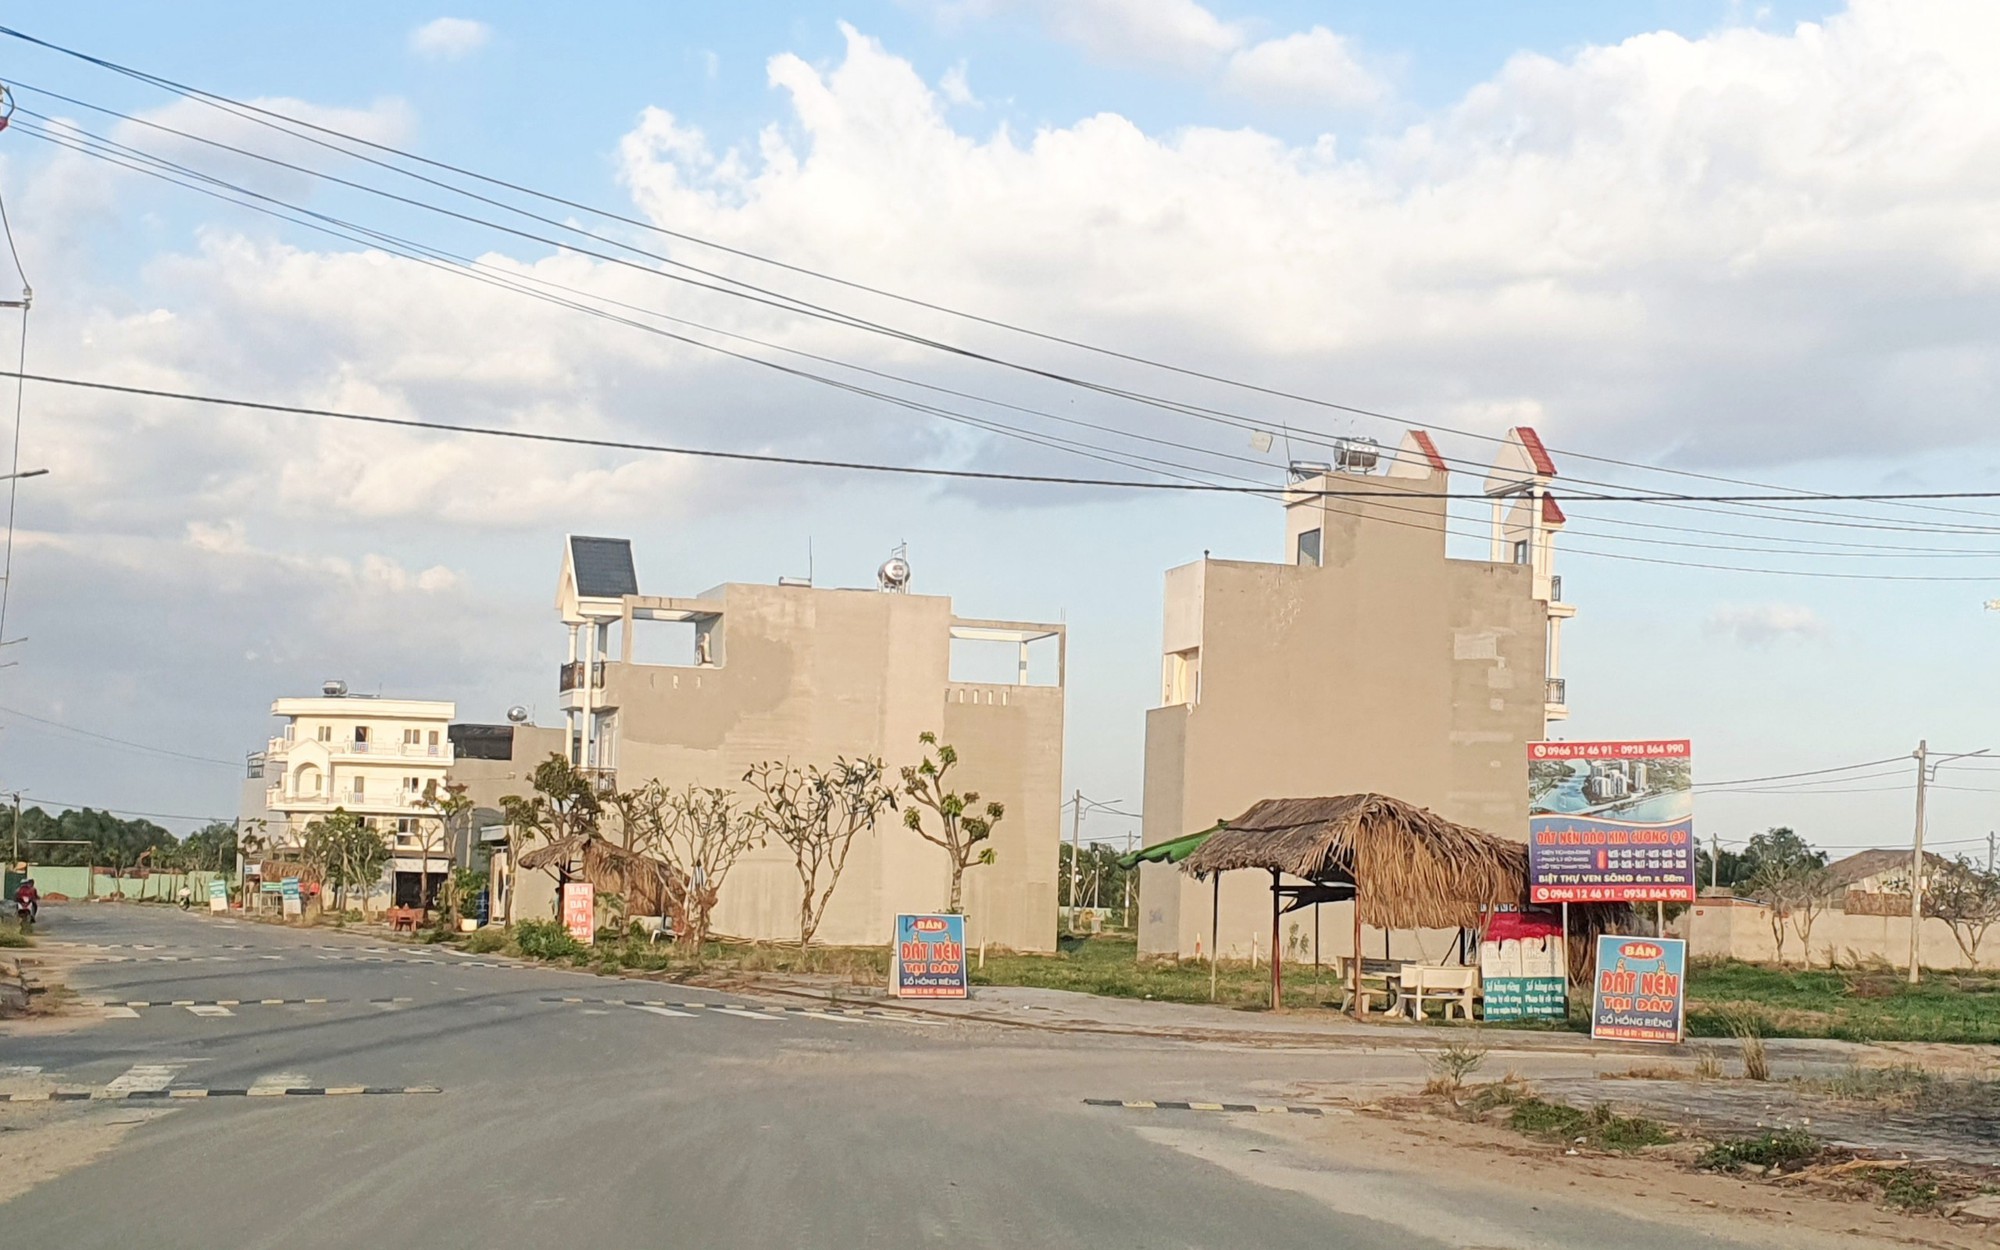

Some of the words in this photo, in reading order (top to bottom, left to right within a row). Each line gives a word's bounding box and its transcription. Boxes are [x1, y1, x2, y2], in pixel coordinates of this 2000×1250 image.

[1547, 746, 1571, 756] 0966
[1574, 746, 1584, 755] 12
[1587, 746, 1599, 755] 46
[1601, 746, 1612, 755] 91
[1620, 745, 1644, 754] 0938
[1647, 744, 1664, 754] 864
[1666, 744, 1684, 754] 990
[1536, 825, 1558, 846] ĐẤT
[1559, 825, 1581, 844] NỀN
[1608, 830, 1628, 844] KIM
[1582, 874, 1602, 882] VEN
[1604, 874, 1634, 882] SÔNG
[1636, 874, 1652, 882] 6m
[1550, 889, 1573, 898] 0966
[1576, 888, 1587, 898] 12
[1590, 888, 1602, 898] 46
[1604, 888, 1615, 898] 91
[1624, 888, 1647, 898] 0938
[1650, 889, 1667, 898] 864
[1670, 889, 1687, 898] 990
[902, 932, 929, 961] ĐẤT
[932, 932, 961, 962] NỀN
[904, 962, 927, 977] TẠI
[930, 961, 960, 976] ĐÂY
[1600, 958, 1637, 995] ĐẤT
[1640, 960, 1679, 997] NỀN
[1602, 996, 1632, 1014] TẠI
[1636, 996, 1674, 1014] ĐÂY
